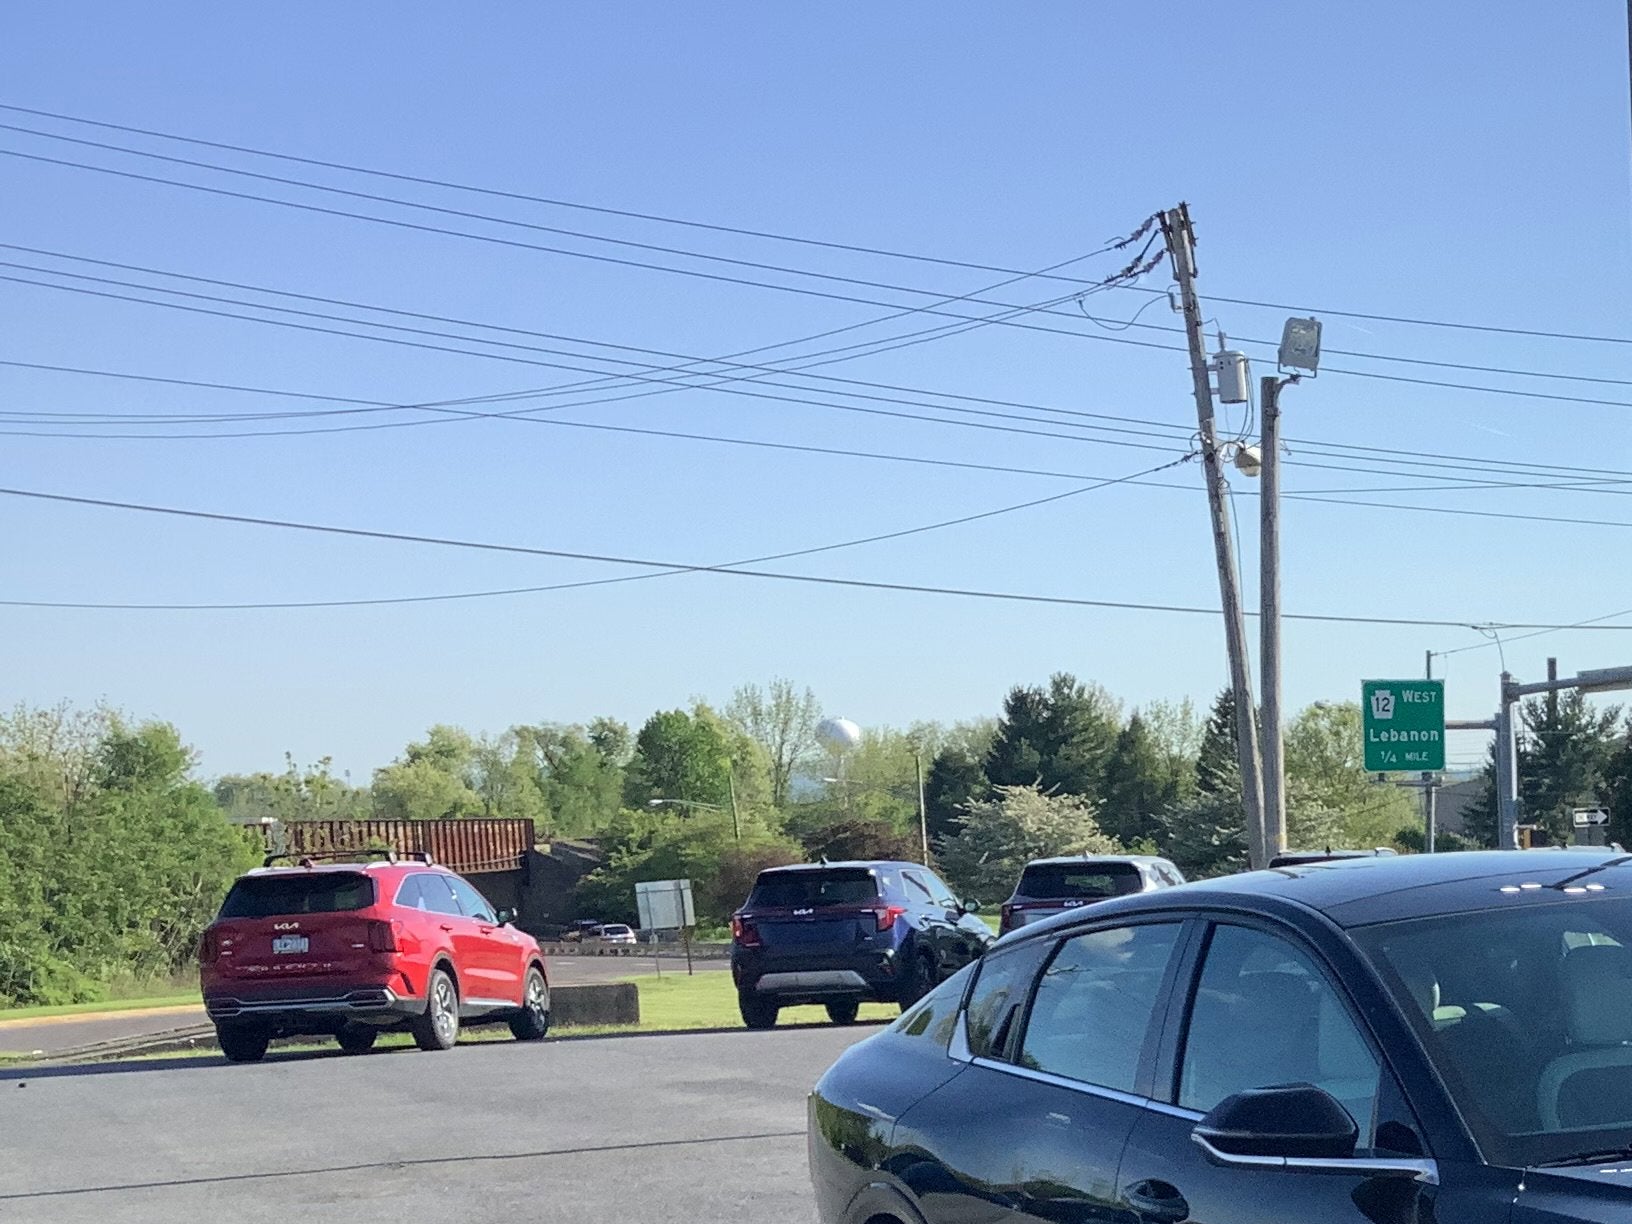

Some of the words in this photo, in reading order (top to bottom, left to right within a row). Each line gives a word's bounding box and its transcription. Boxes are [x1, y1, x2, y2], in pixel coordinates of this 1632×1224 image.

[1402, 690, 1437, 703] WEST
[1375, 697, 1391, 713] 12
[1369, 728, 1439, 742] Lebanon
[1405, 751, 1429, 762] MILE
